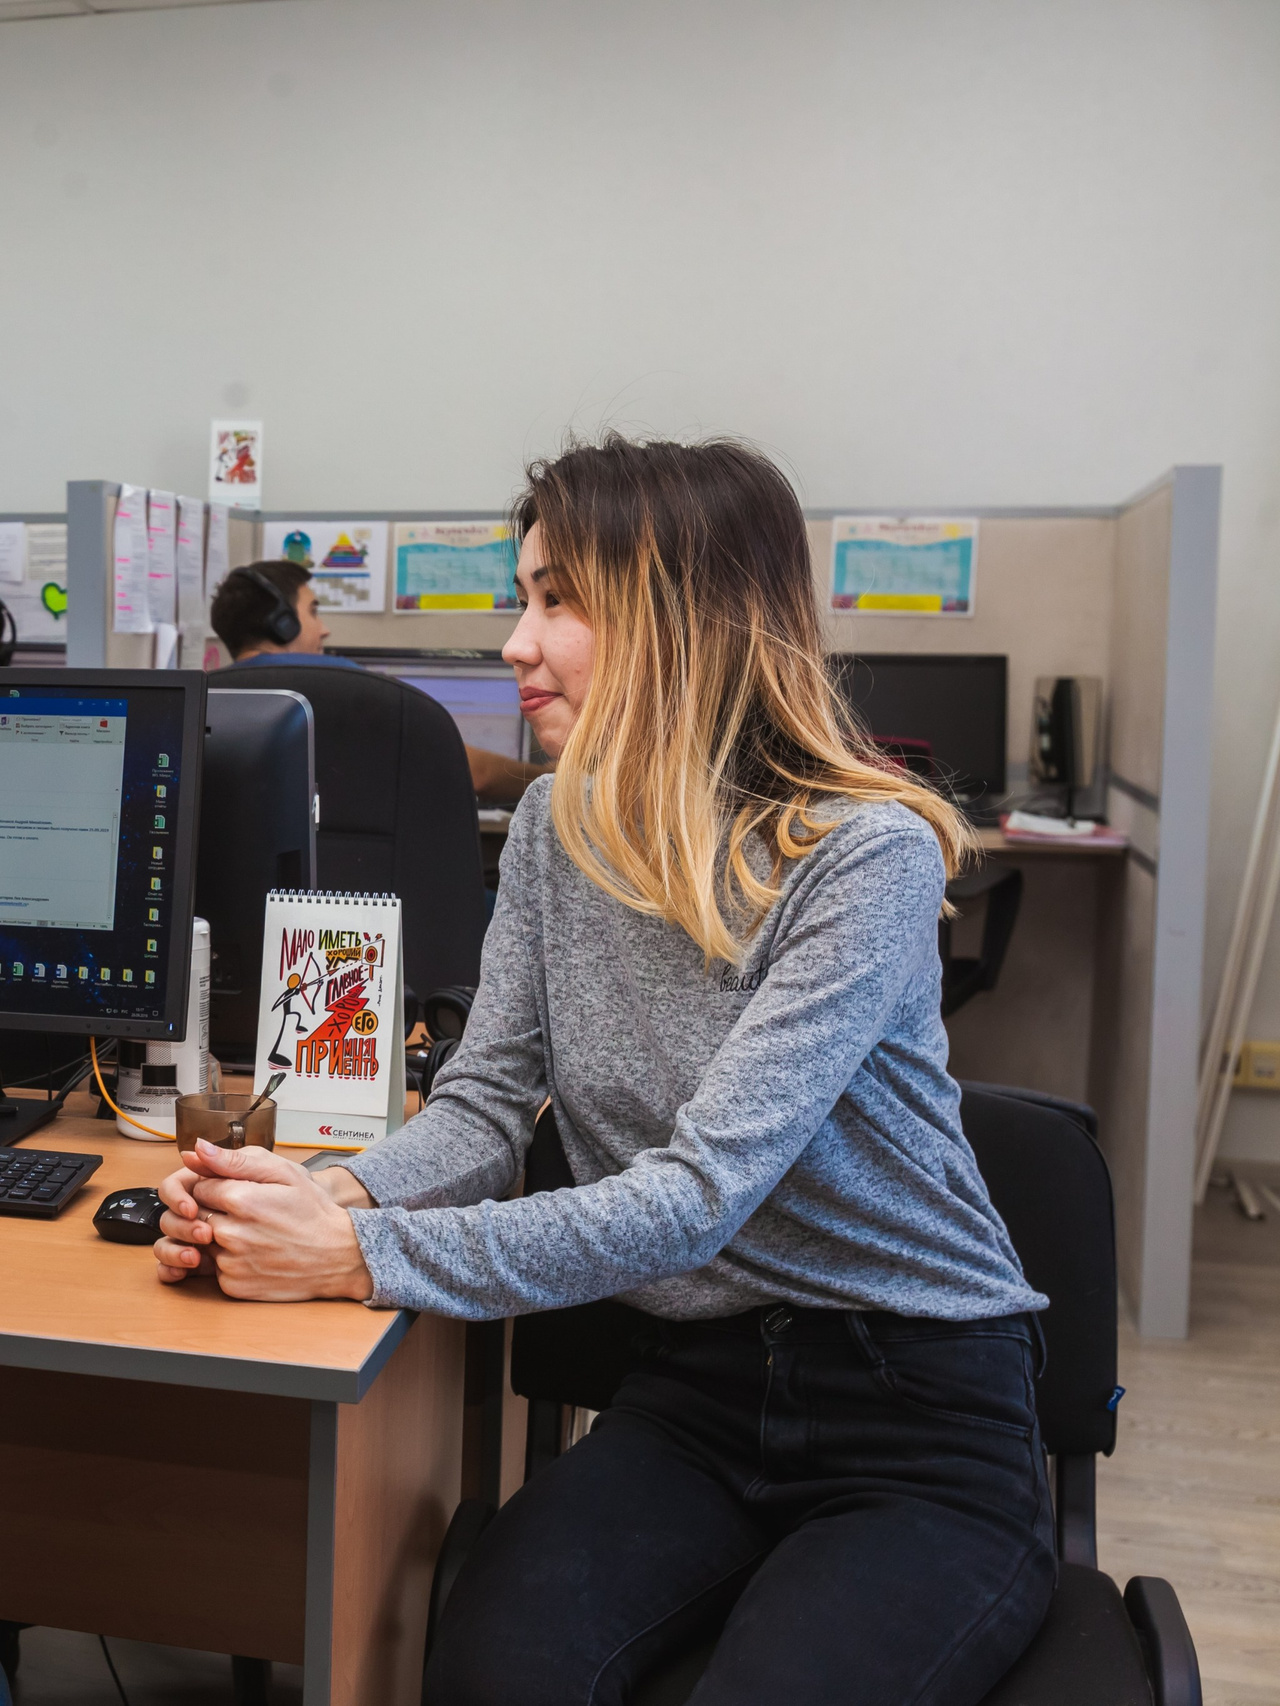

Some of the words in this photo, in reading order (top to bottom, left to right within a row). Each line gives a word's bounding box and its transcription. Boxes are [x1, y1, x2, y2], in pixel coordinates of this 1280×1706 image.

[279, 927, 315, 981] МАЛО
[318, 929, 362, 951] ИМЕТЬ
[326, 946, 361, 958] ХОРОШИЙ
[325, 955, 358, 971] УМ
[354, 1011, 375, 1032] ЕГО
[332, 1129, 375, 1140] СЕНТИНЕЛ
